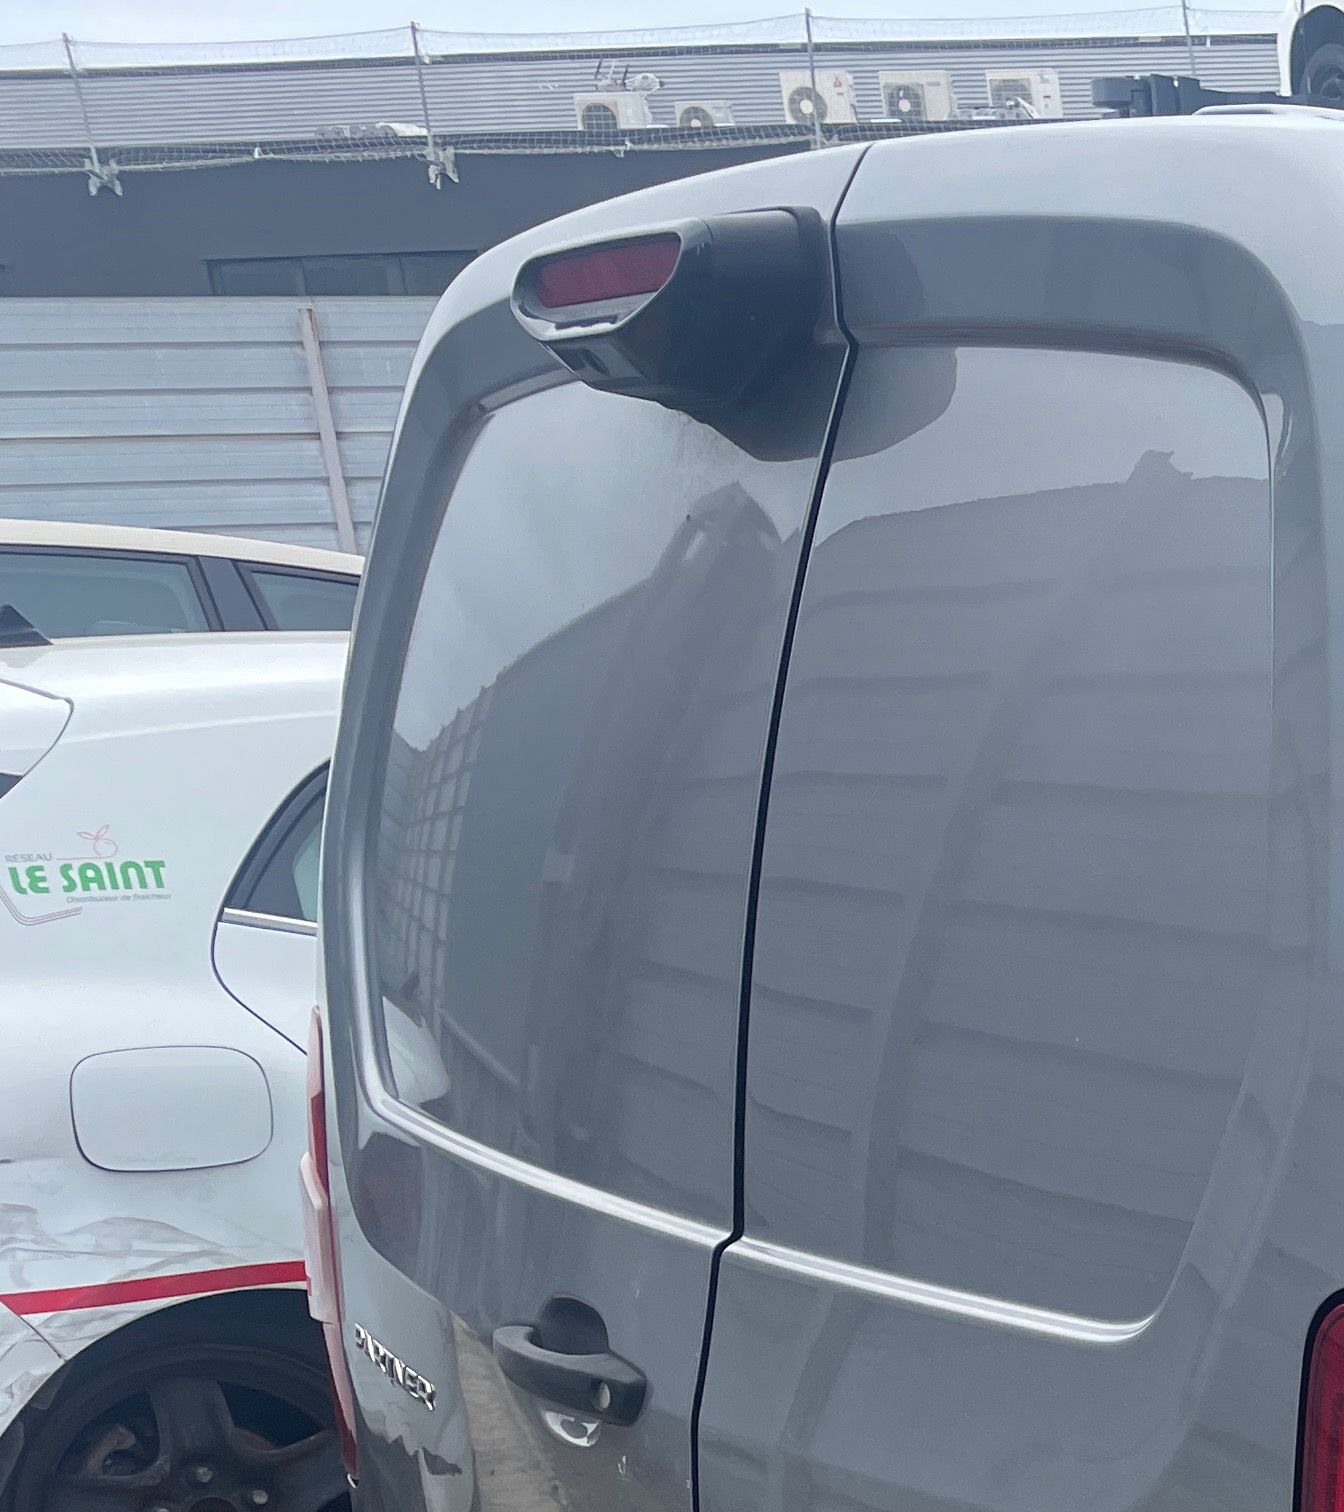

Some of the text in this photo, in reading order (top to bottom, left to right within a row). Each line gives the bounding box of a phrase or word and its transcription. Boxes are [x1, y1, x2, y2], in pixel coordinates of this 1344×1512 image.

[8, 859, 166, 895] LE SAINT
[354, 1321, 437, 1412] PARTNER
